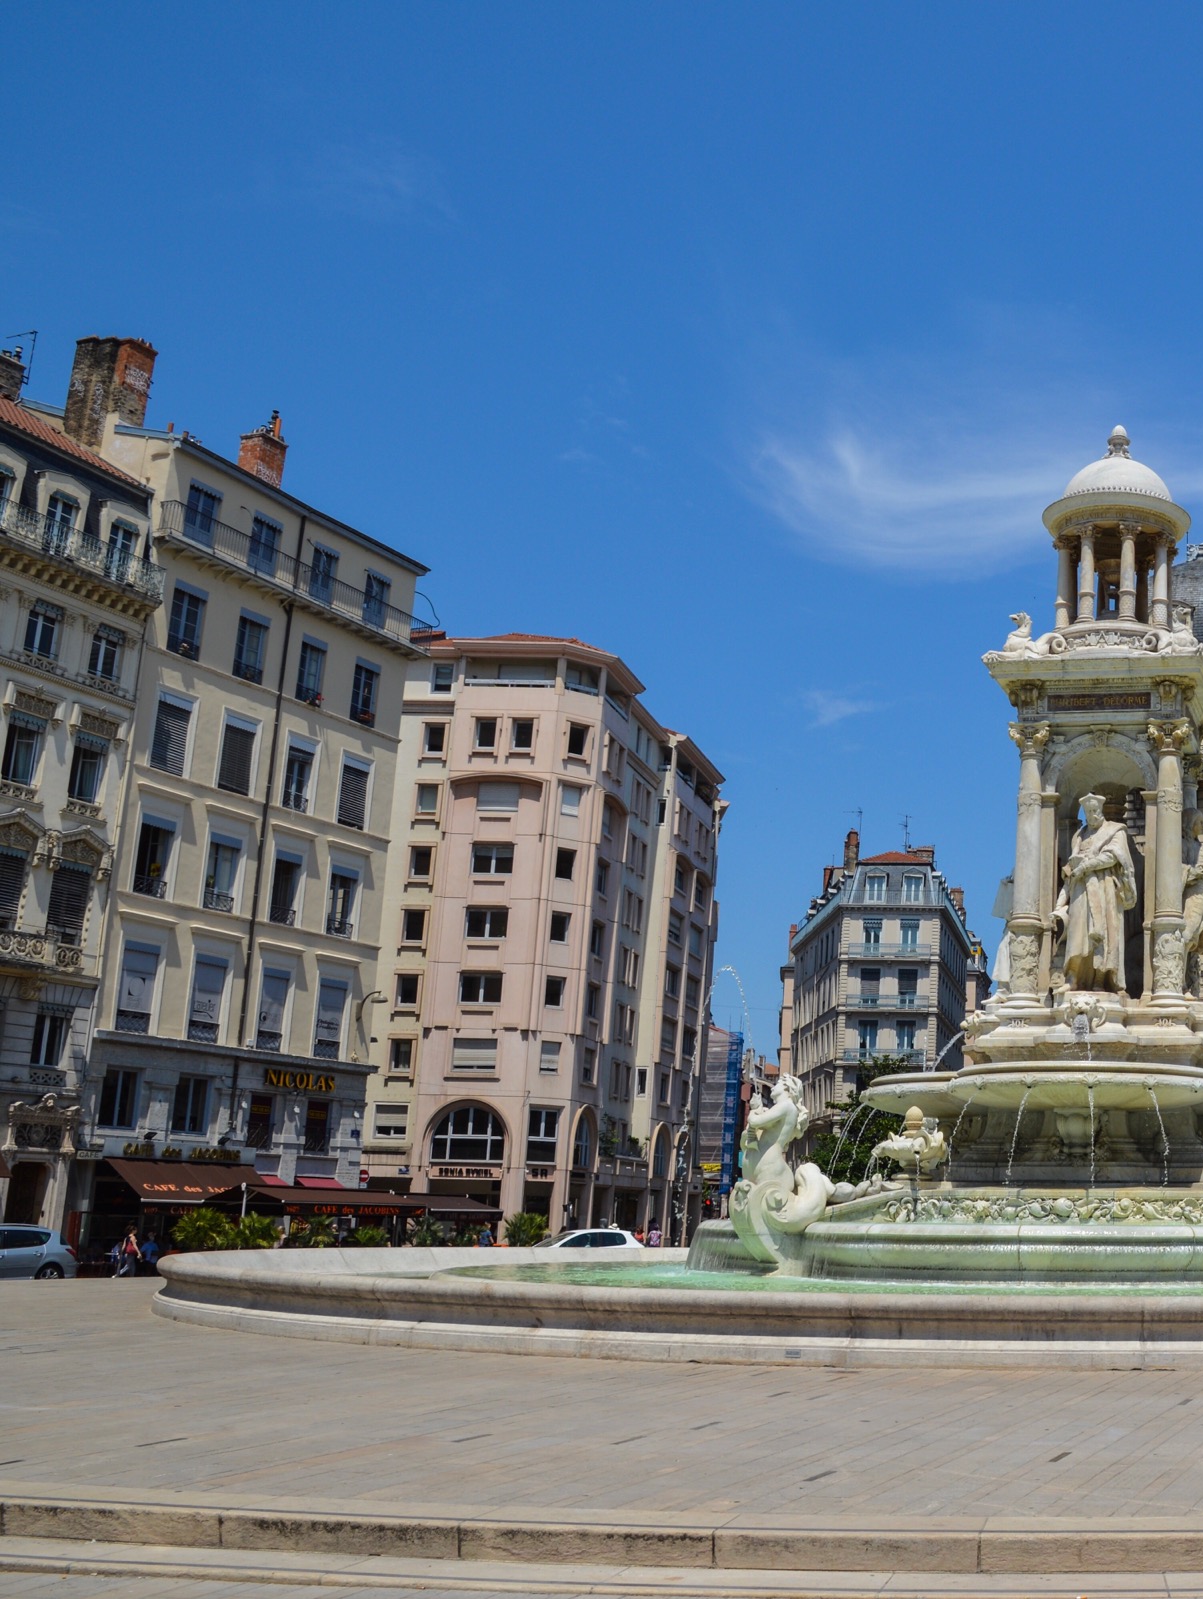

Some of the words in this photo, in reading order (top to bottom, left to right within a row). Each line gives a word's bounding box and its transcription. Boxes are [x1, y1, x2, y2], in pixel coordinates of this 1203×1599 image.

[265, 1068, 336, 1092] NICOLAS
[438, 1167, 464, 1177] SONIA
[143, 1183, 179, 1192] CAFE
[183, 1185, 203, 1193] des
[314, 1204, 338, 1214] CAFE
[342, 1204, 355, 1214] des
[358, 1206, 400, 1215] JACOBINS
